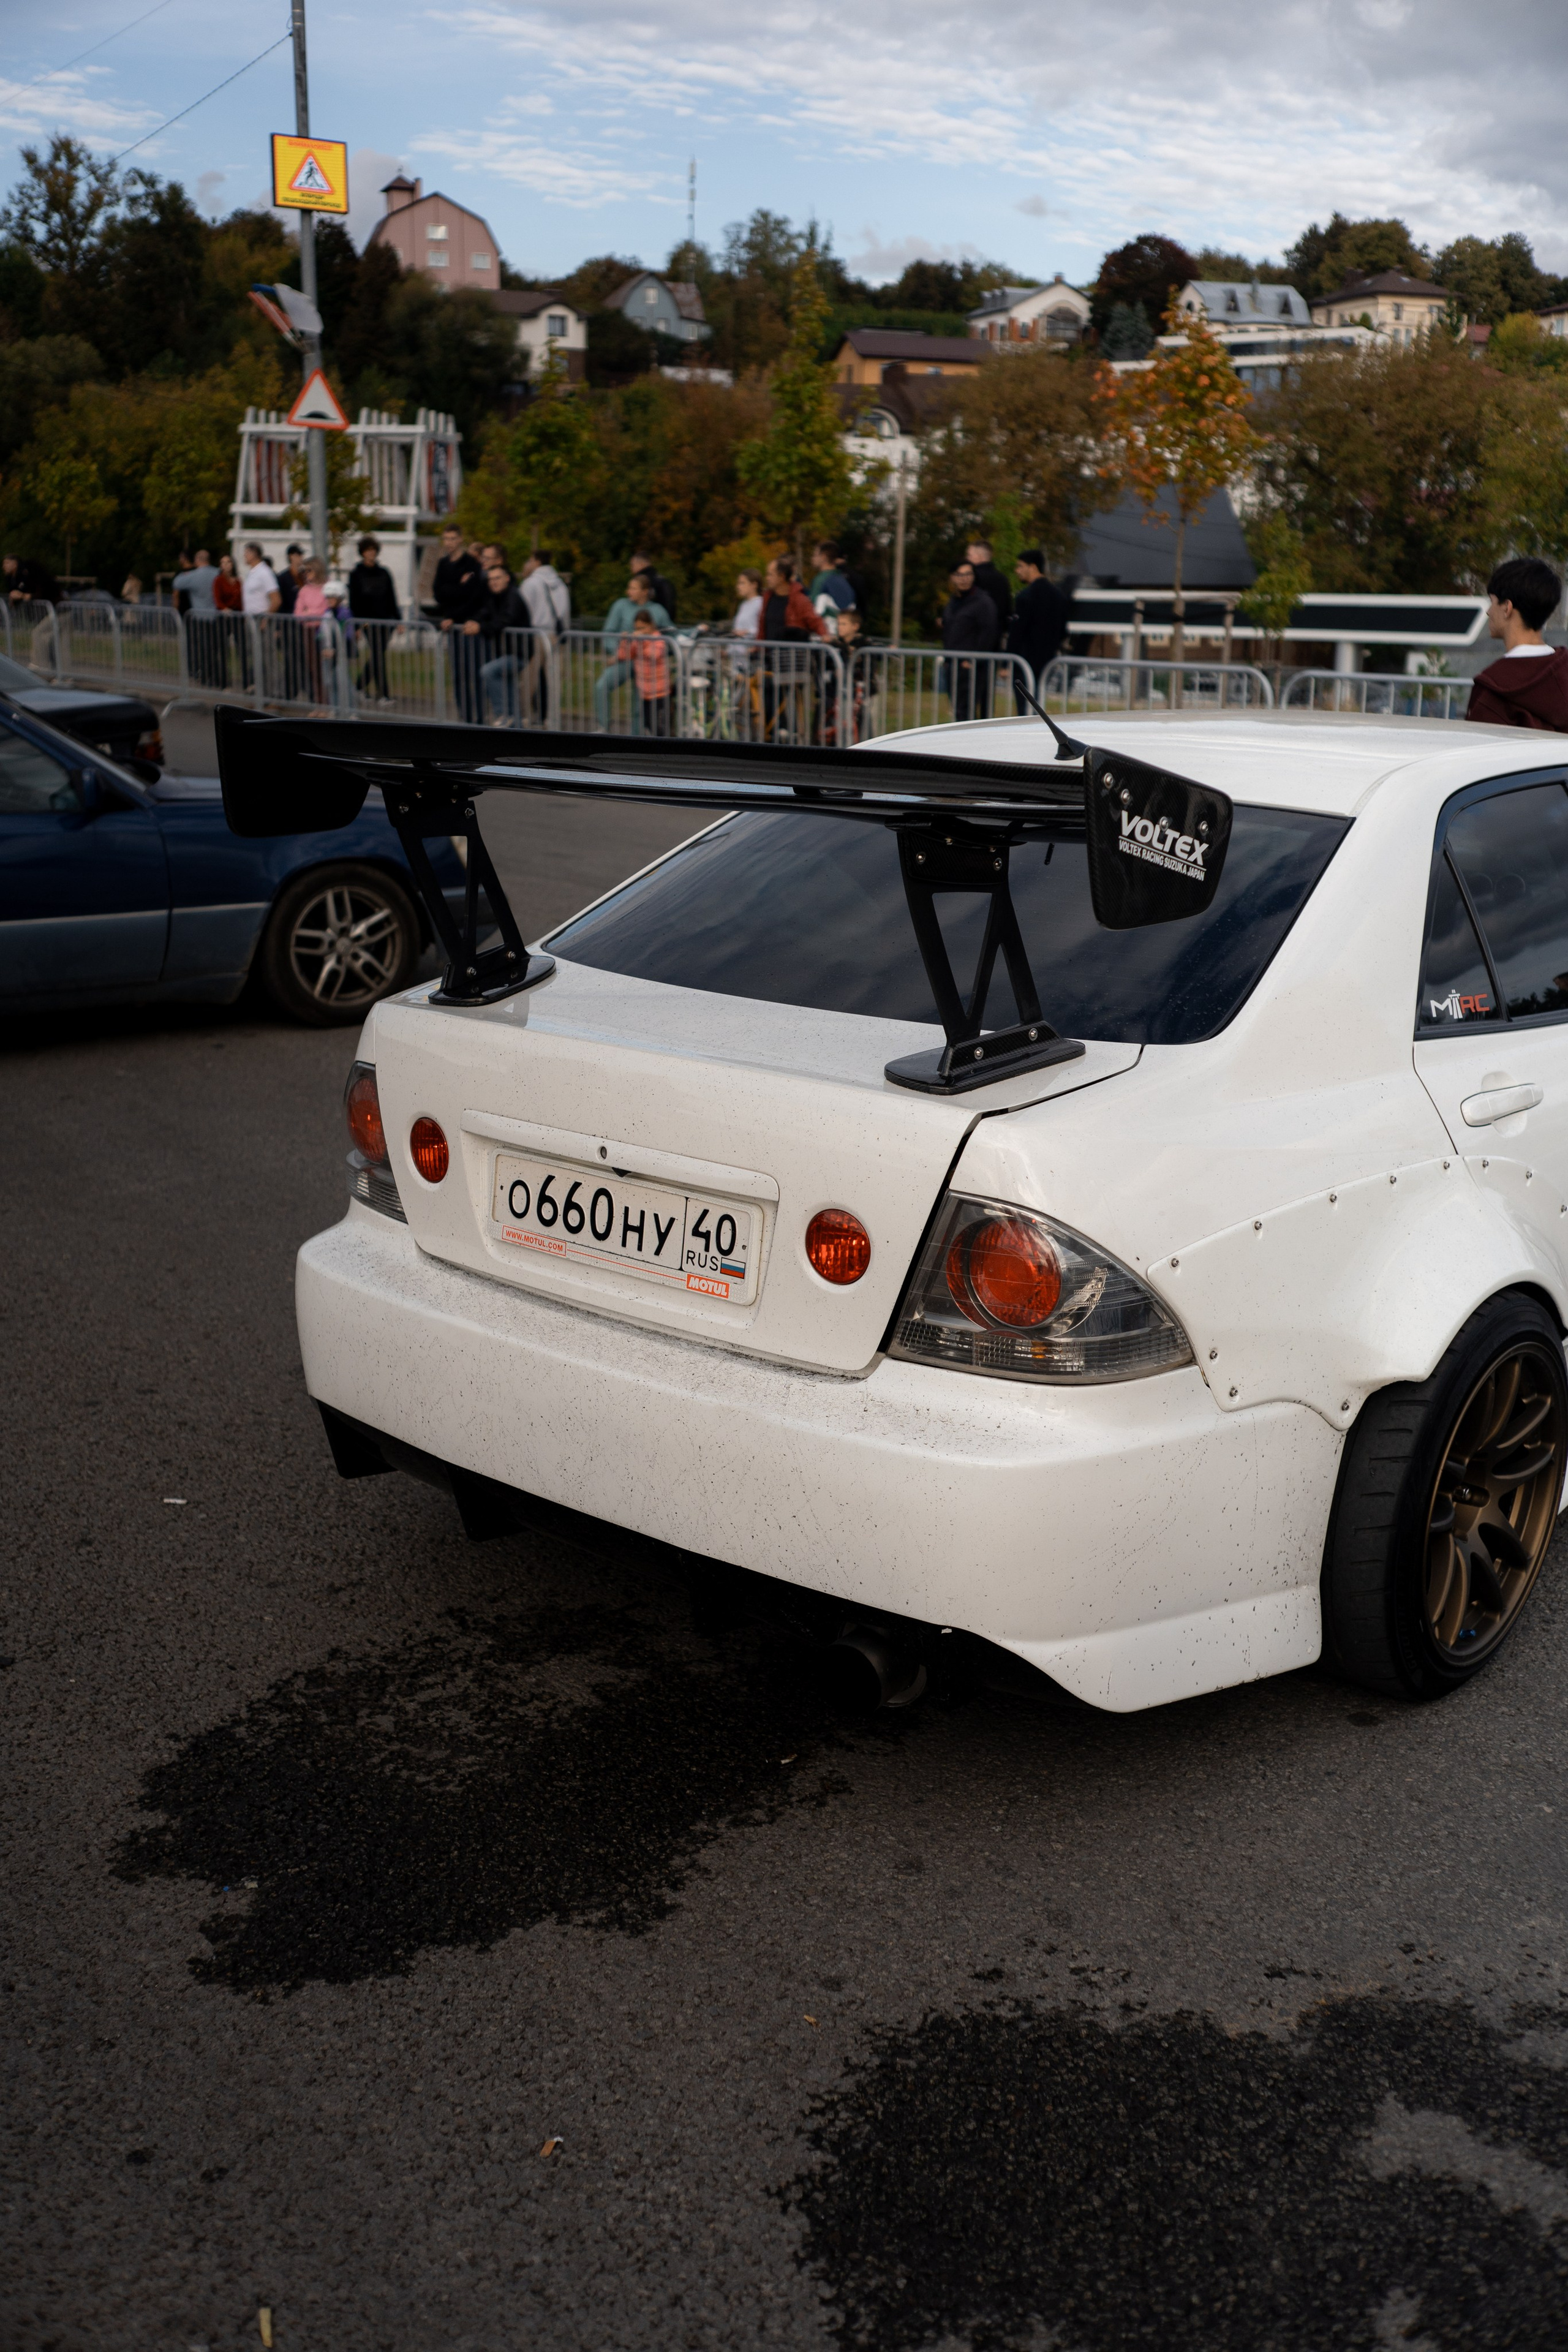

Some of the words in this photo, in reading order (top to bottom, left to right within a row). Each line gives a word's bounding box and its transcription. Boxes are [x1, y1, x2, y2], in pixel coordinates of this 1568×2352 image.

[1121, 810, 1209, 865] VOLTEX
[1119, 839, 1141, 857] VOLTEX
[1142, 848, 1164, 865] RACING
[1164, 858, 1187, 875] SUZUKA
[1187, 867, 1205, 881] JAPAN
[505, 1229, 563, 1252] WWW.MOTUL.COM
[691, 1209, 737, 1257] 40
[686, 1250, 719, 1272] RUS
[688, 1276, 728, 1296] MOTUL
